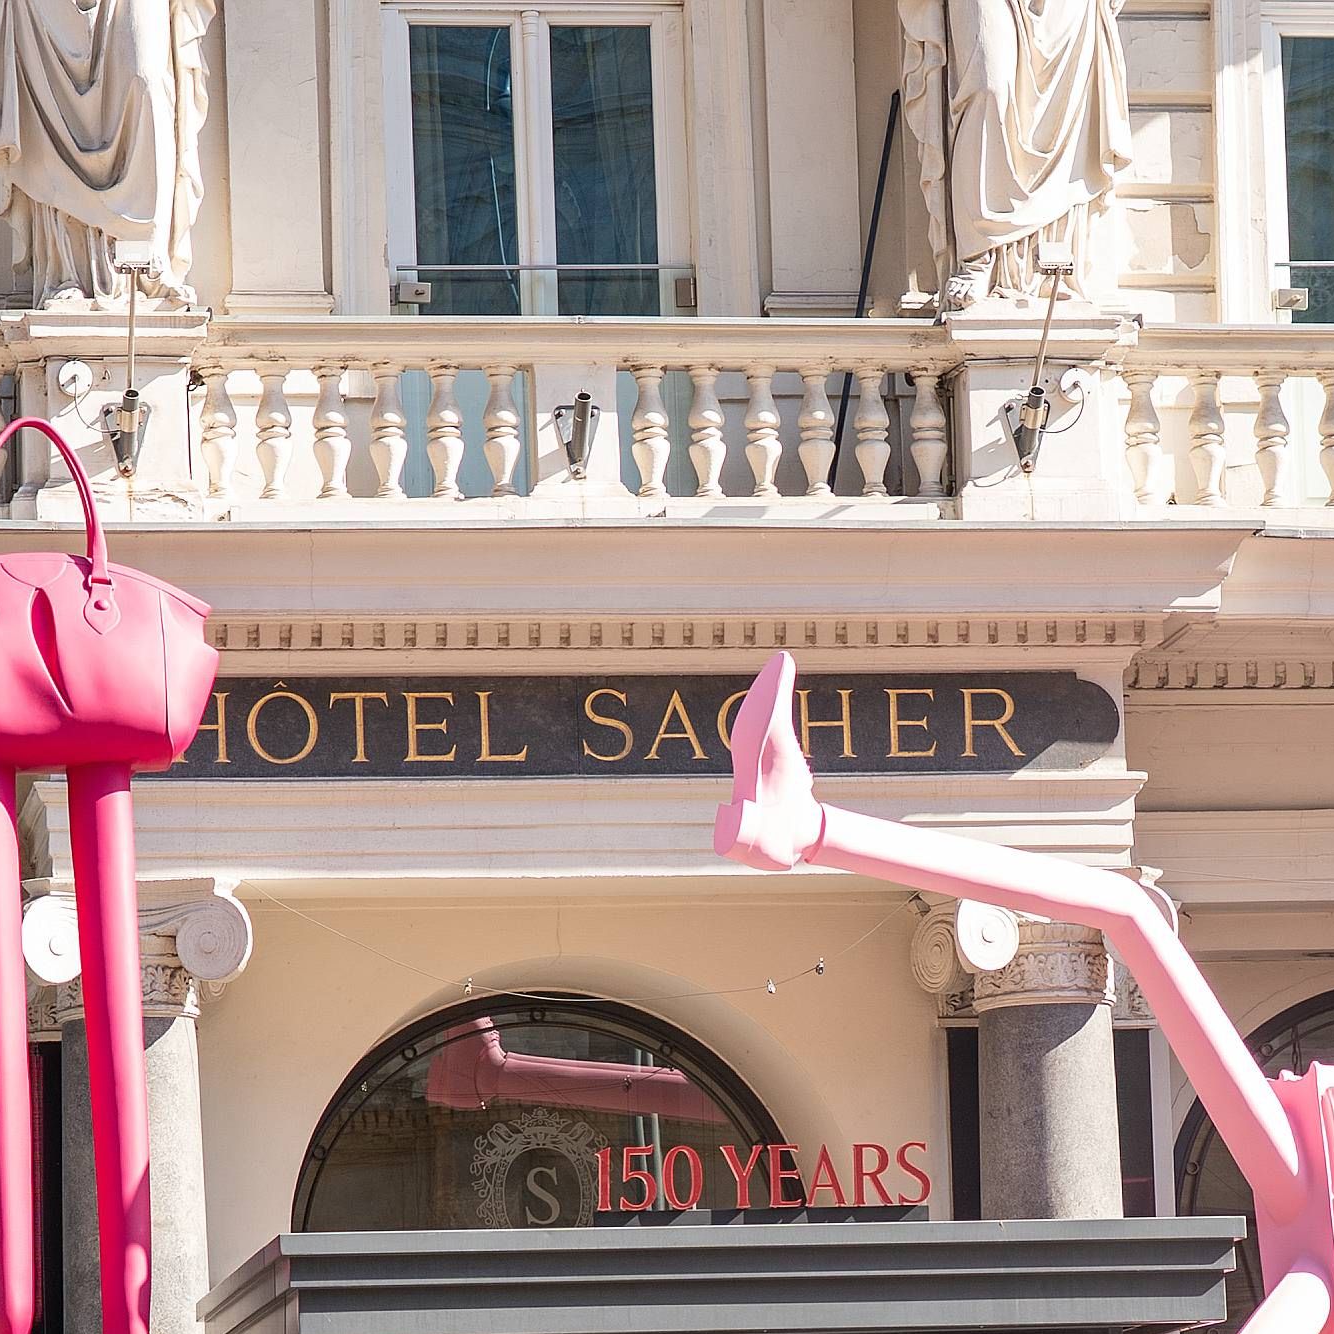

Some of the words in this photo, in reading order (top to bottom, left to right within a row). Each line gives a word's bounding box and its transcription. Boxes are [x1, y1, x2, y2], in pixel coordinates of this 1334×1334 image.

[525, 1166, 561, 1225] S
[594, 1144, 704, 1212] 150
[718, 1141, 933, 1210] YEARS
